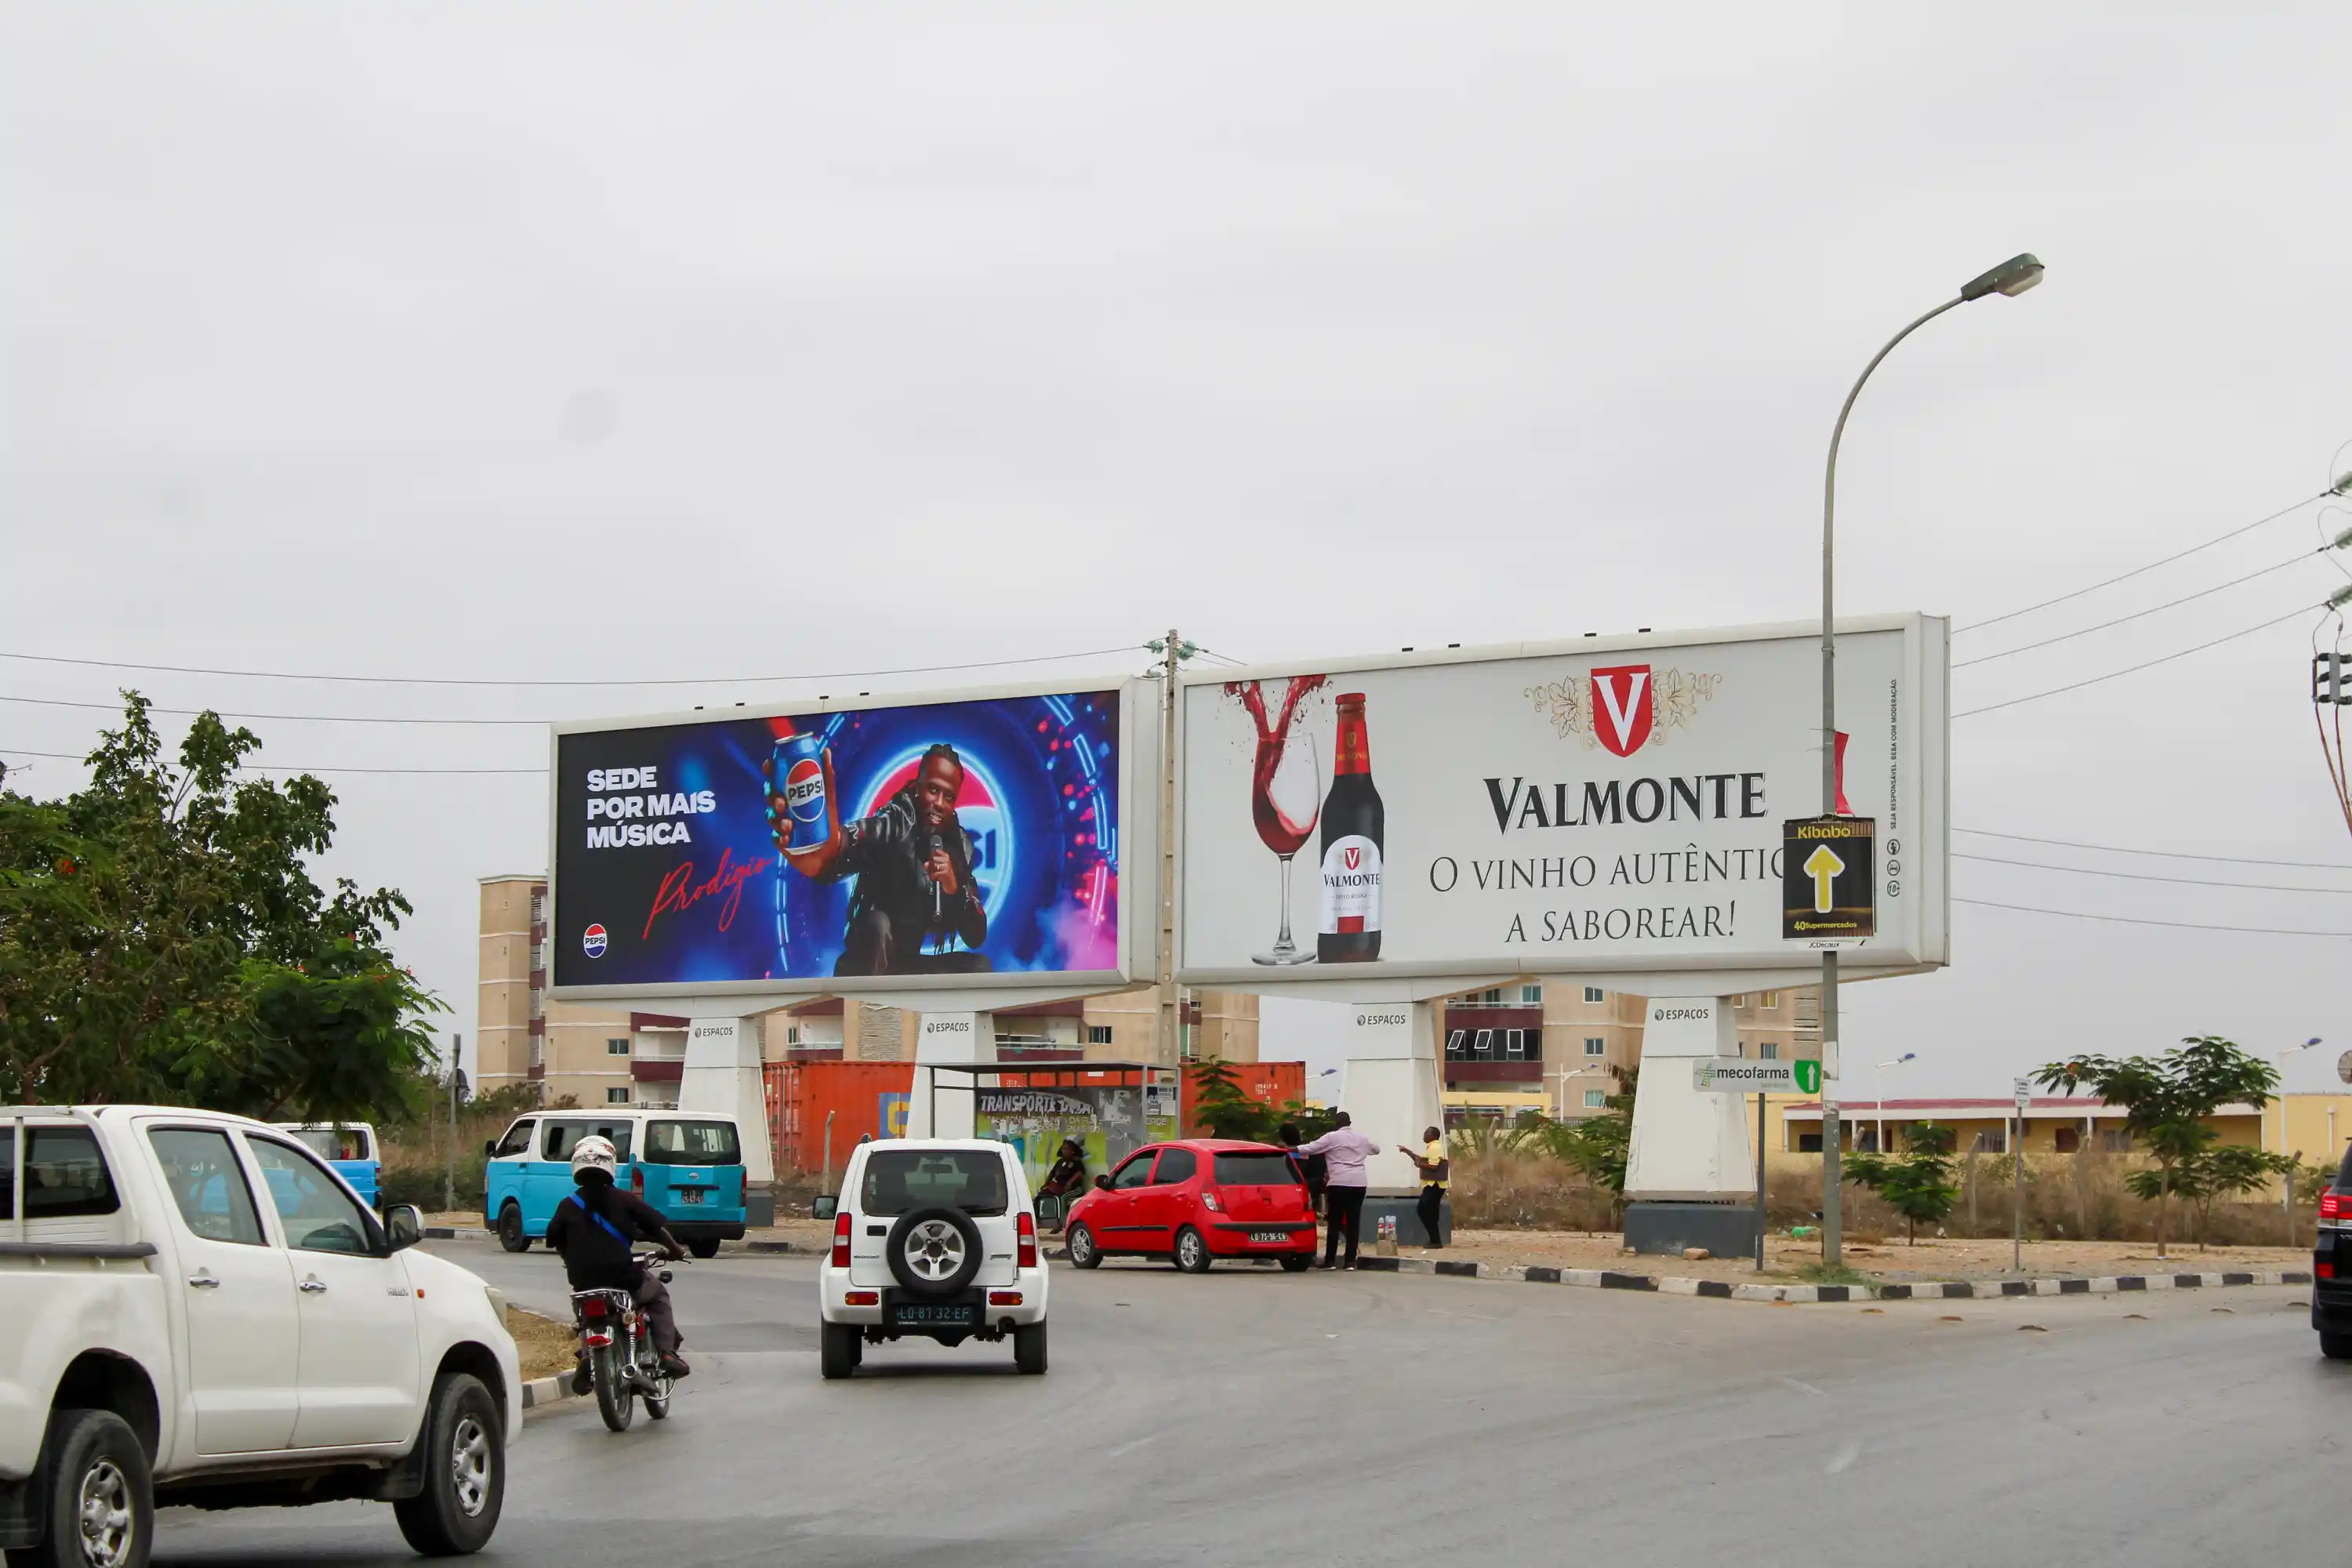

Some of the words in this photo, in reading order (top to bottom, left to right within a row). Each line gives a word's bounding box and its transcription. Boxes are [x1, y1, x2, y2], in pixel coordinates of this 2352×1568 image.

[1592, 673, 1649, 751] V
[586, 765, 657, 792] SEDE
[788, 779, 823, 800] PEPSI
[586, 796, 644, 820] POR
[647, 790, 716, 817] MAIS
[1483, 771, 1769, 836] VALMONTE
[586, 820, 691, 848] MÚSICA
[1797, 826, 1851, 840] Kibabo
[1323, 873, 1380, 888] VALMONTE
[1429, 856, 1458, 892] O
[1471, 855, 1596, 891] VINHO
[1609, 842, 1784, 886] AUTÊNTIC
[1504, 913, 1528, 943] A
[1541, 899, 1736, 942] SABOREAR!
[1717, 1066, 1789, 1080] mecofarma
